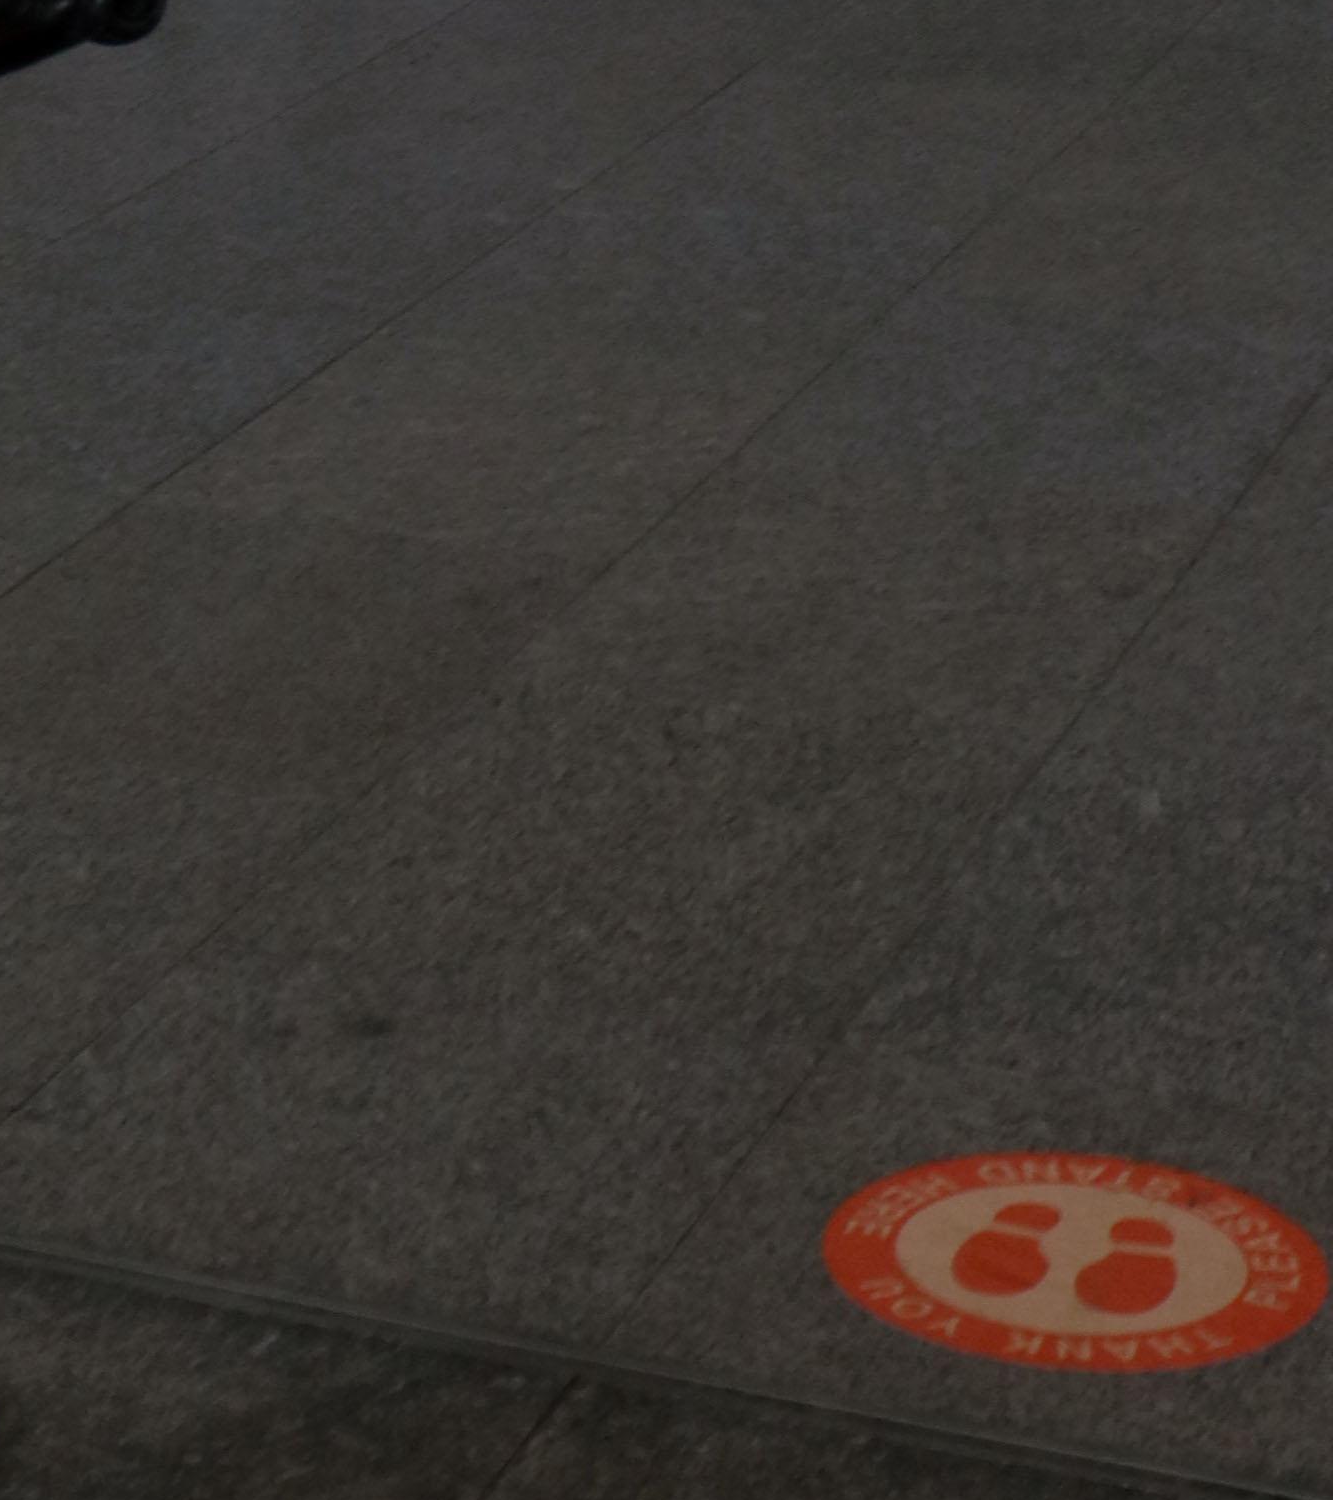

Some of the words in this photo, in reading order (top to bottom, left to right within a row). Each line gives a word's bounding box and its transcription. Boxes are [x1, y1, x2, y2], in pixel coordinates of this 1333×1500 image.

[976, 1159, 1183, 1201] STAND
[842, 1173, 957, 1240] HERE
[859, 1277, 961, 1339] YOU
[1002, 1330, 1237, 1361] THANK
